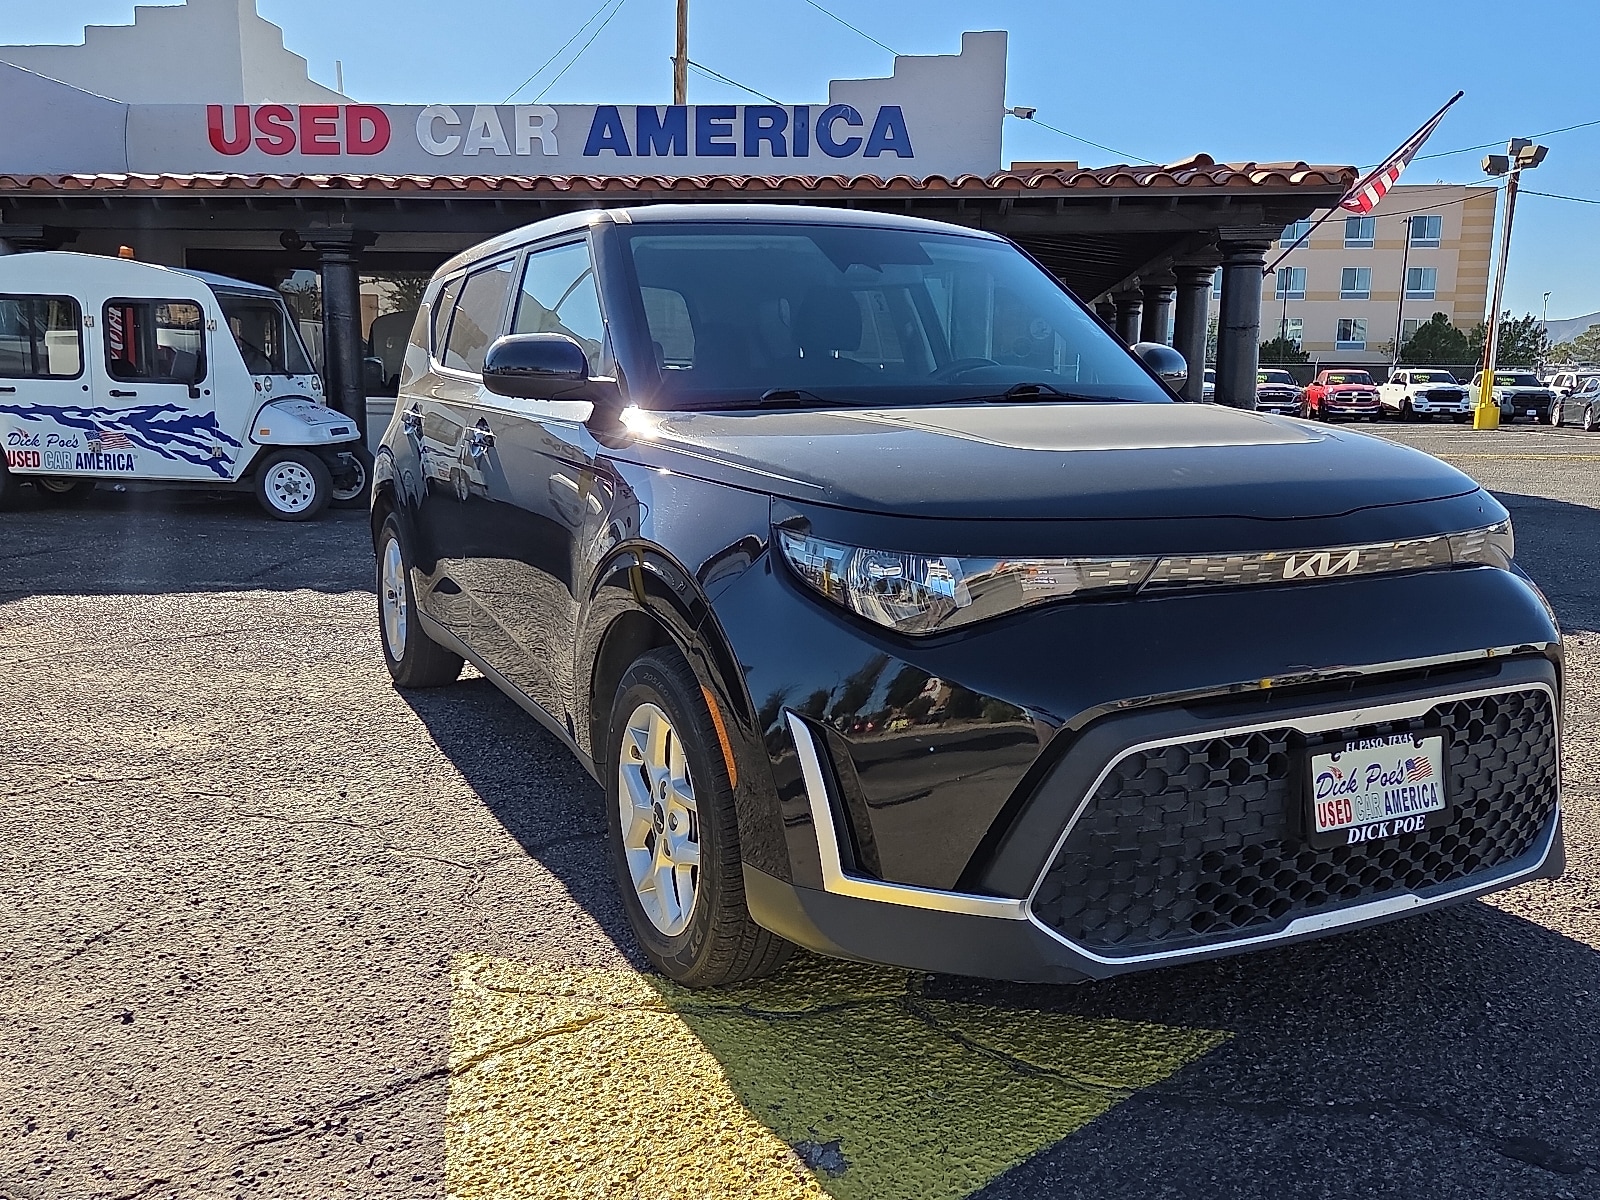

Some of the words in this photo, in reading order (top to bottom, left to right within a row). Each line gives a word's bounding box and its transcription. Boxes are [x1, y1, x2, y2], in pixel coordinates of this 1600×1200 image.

[207, 104, 392, 156] USED
[416, 104, 559, 156] CAR
[582, 103, 915, 158] AMERICA
[7, 432, 41, 447] Dick
[46, 433, 80, 449] Poe's
[7, 450, 41, 468] USED
[44, 450, 73, 470] CAR
[75, 452, 135, 471] AMERICA
[1282, 550, 1360, 579] KIA
[1346, 742, 1357, 752] EL
[1388, 733, 1414, 746] TEXAS
[1316, 767, 1359, 800] Dick
[1365, 758, 1406, 792] Poe's
[1317, 798, 1353, 828] USED
[1355, 792, 1383, 821] CAR
[1384, 782, 1439, 816] AMERICA
[1346, 820, 1392, 845] DICK
[1393, 814, 1426, 836] POE
